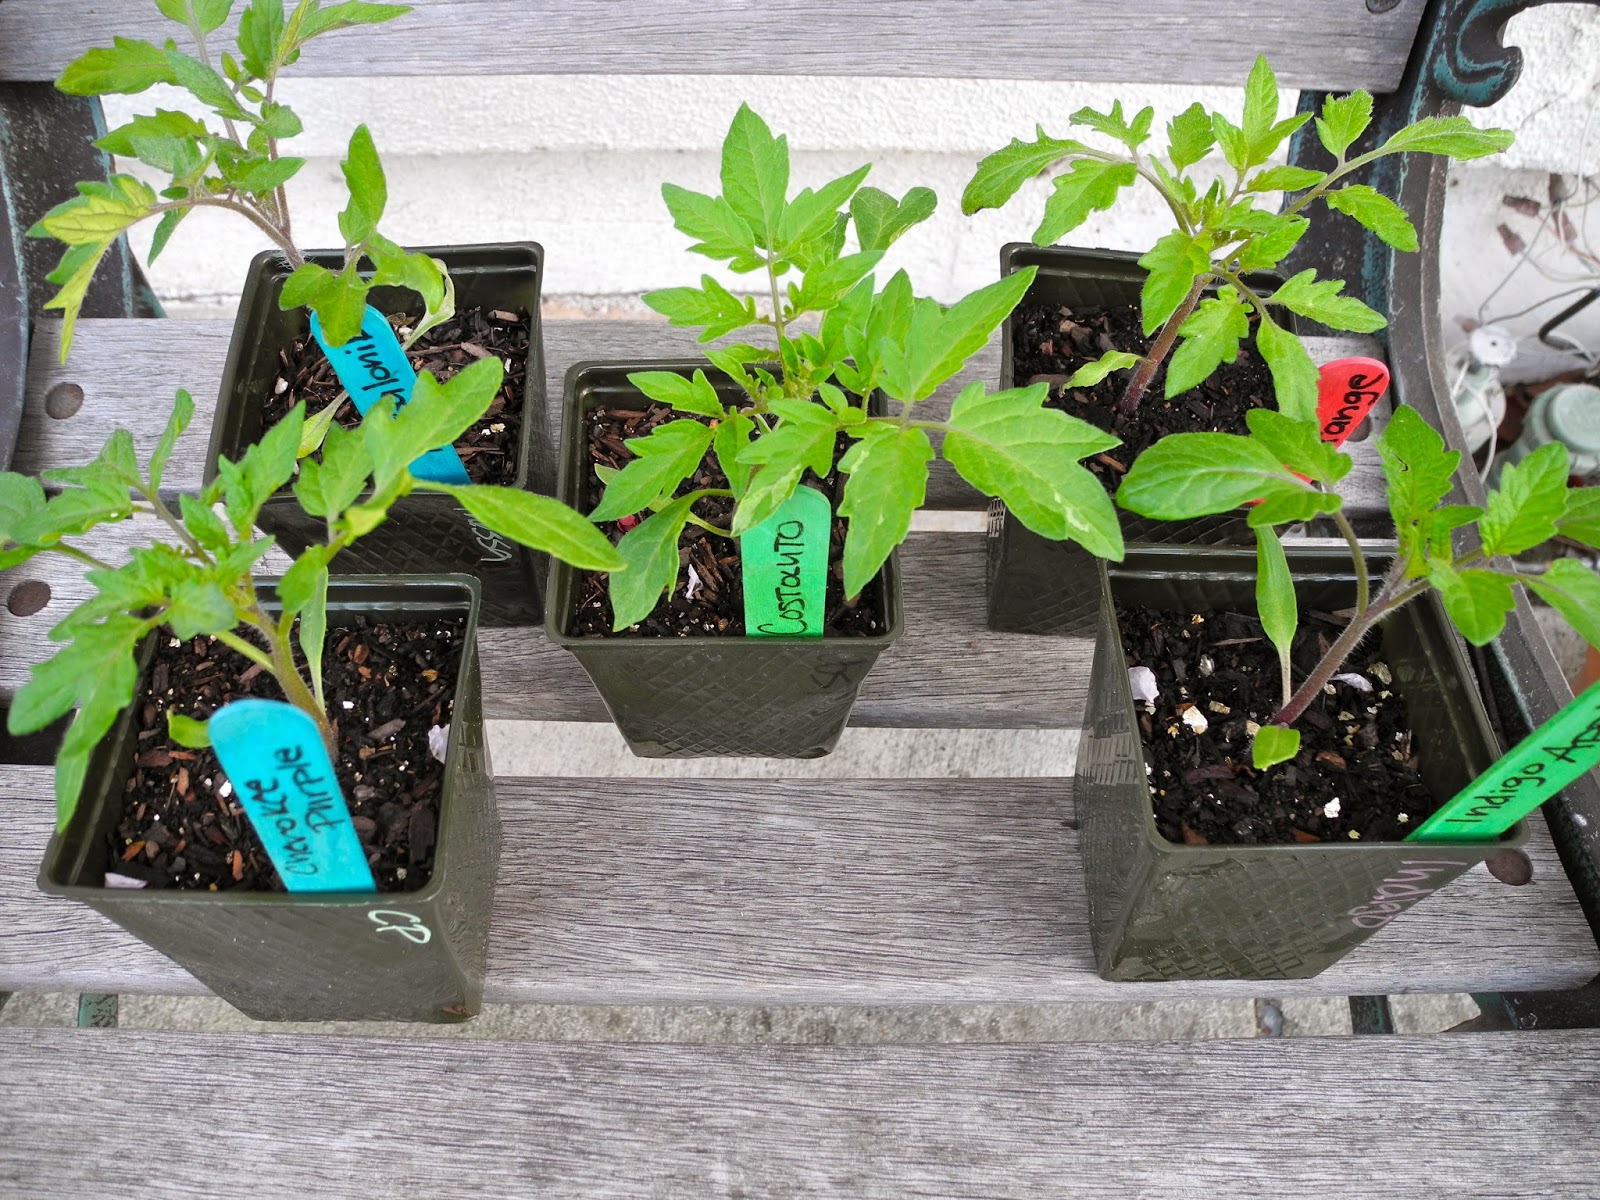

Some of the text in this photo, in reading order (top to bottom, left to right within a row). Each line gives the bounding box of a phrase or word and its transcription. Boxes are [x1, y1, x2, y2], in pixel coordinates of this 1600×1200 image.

[1320, 372, 1385, 444] range
[273, 744, 346, 833] Purple
[1445, 705, 1600, 823] Indigo App
